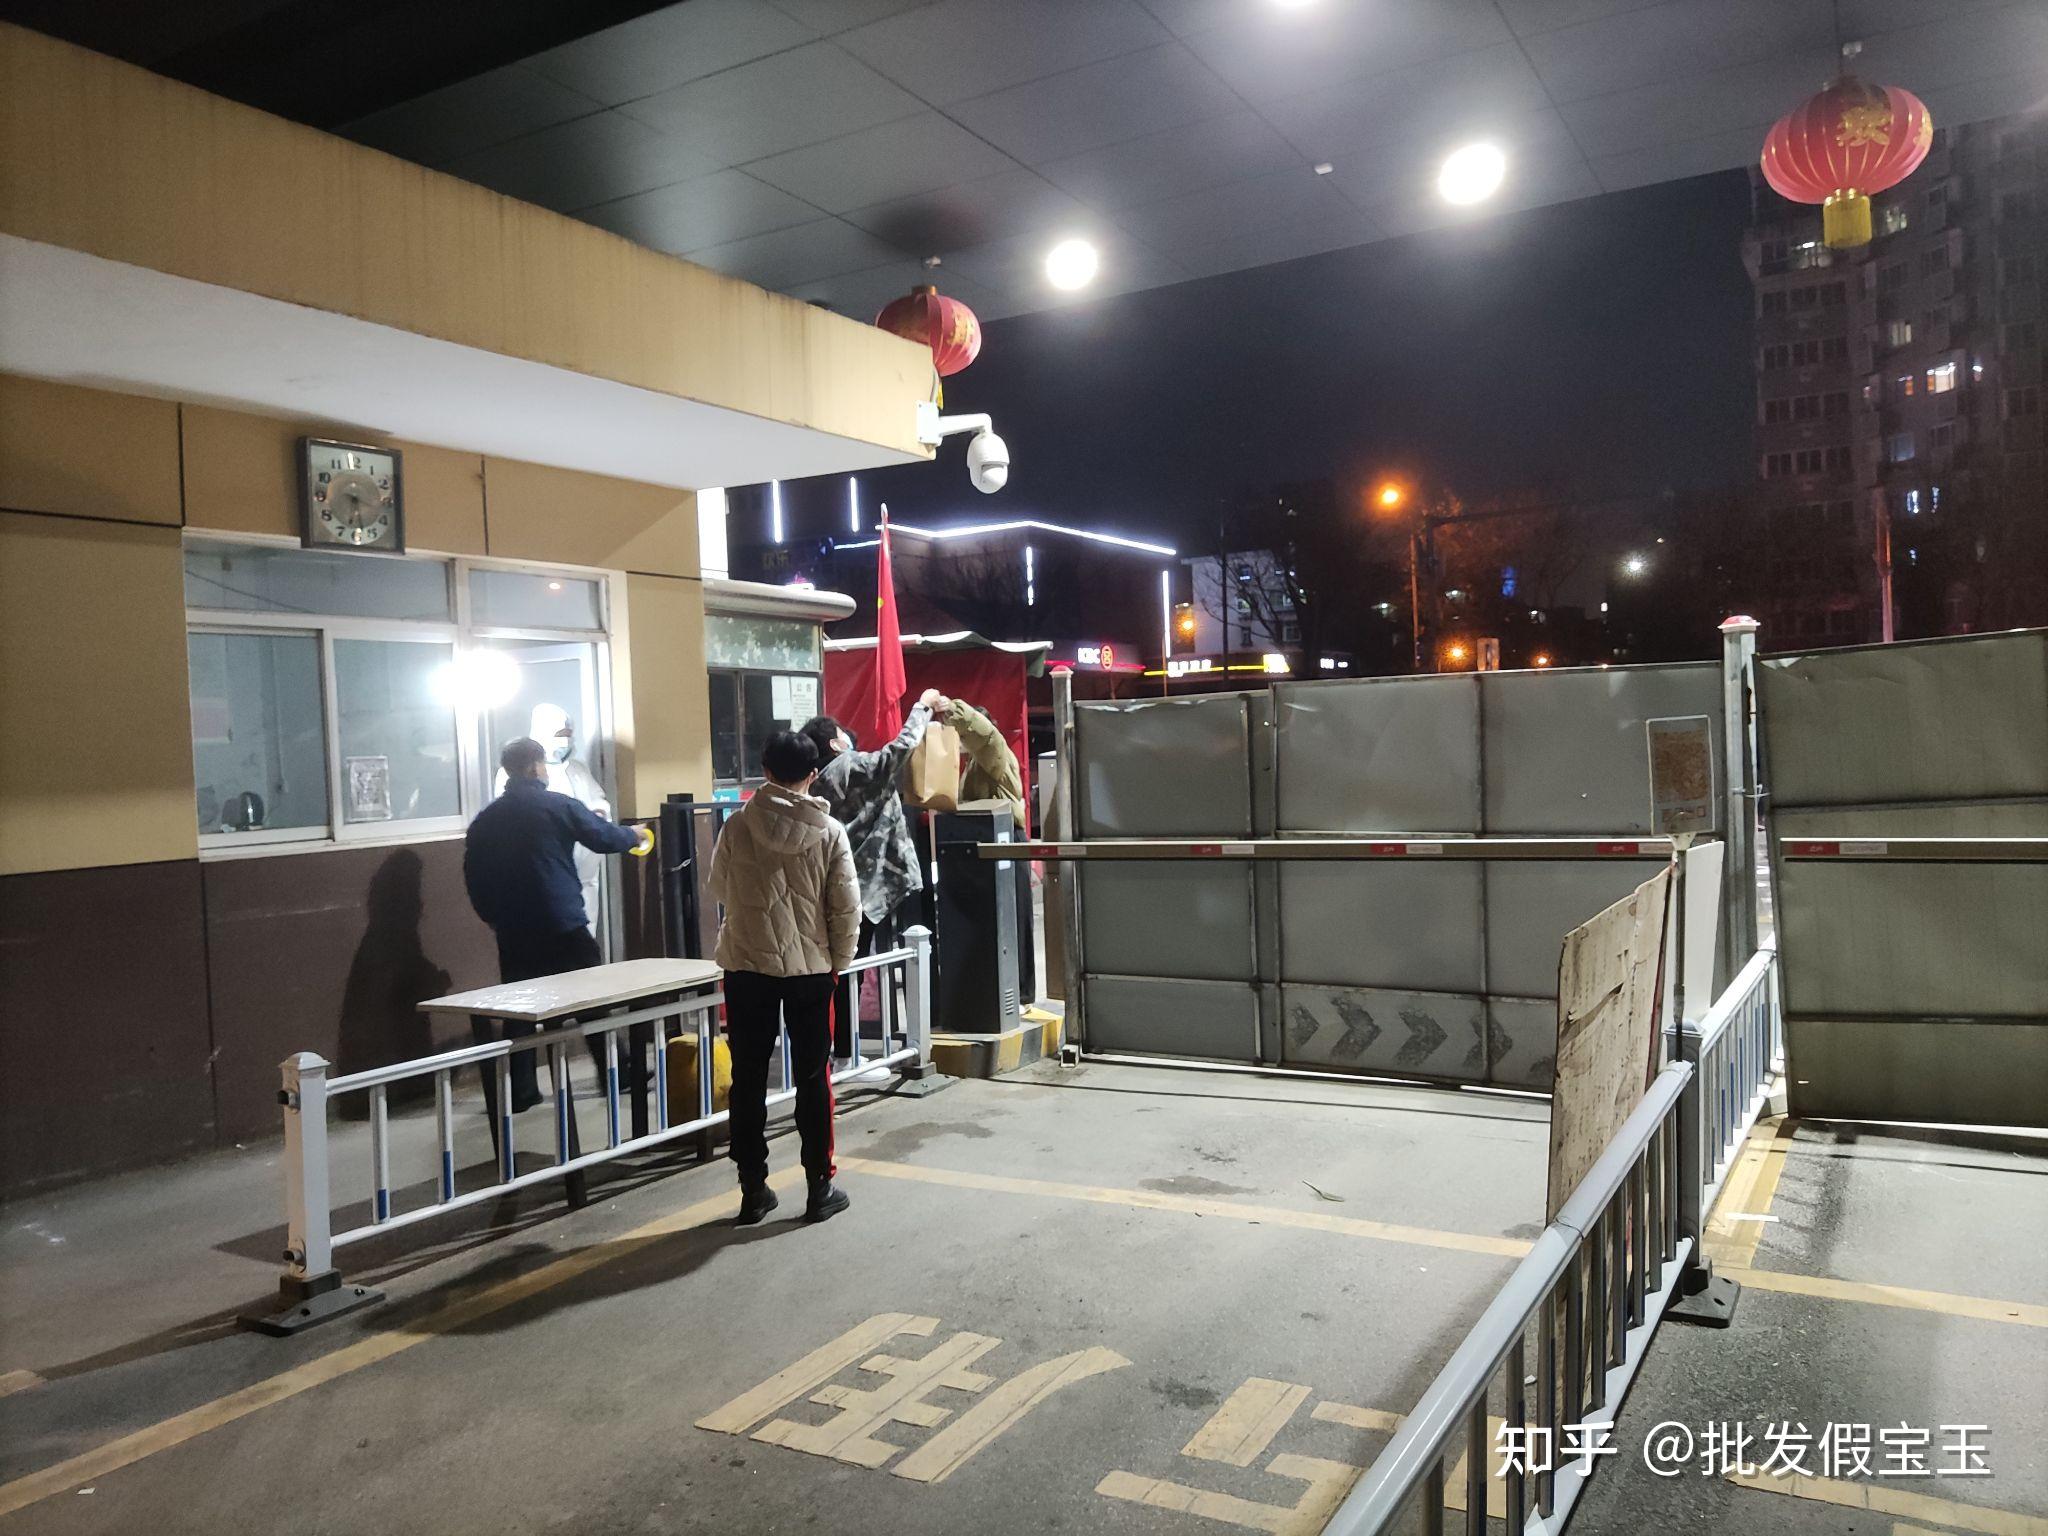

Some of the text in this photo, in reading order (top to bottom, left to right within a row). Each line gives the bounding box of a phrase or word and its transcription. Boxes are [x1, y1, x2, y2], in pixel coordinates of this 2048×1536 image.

[331, 459, 341, 470] 11
[319, 472, 331, 484] 10
[336, 526, 345, 537] 7
[367, 528, 377, 539] 5
